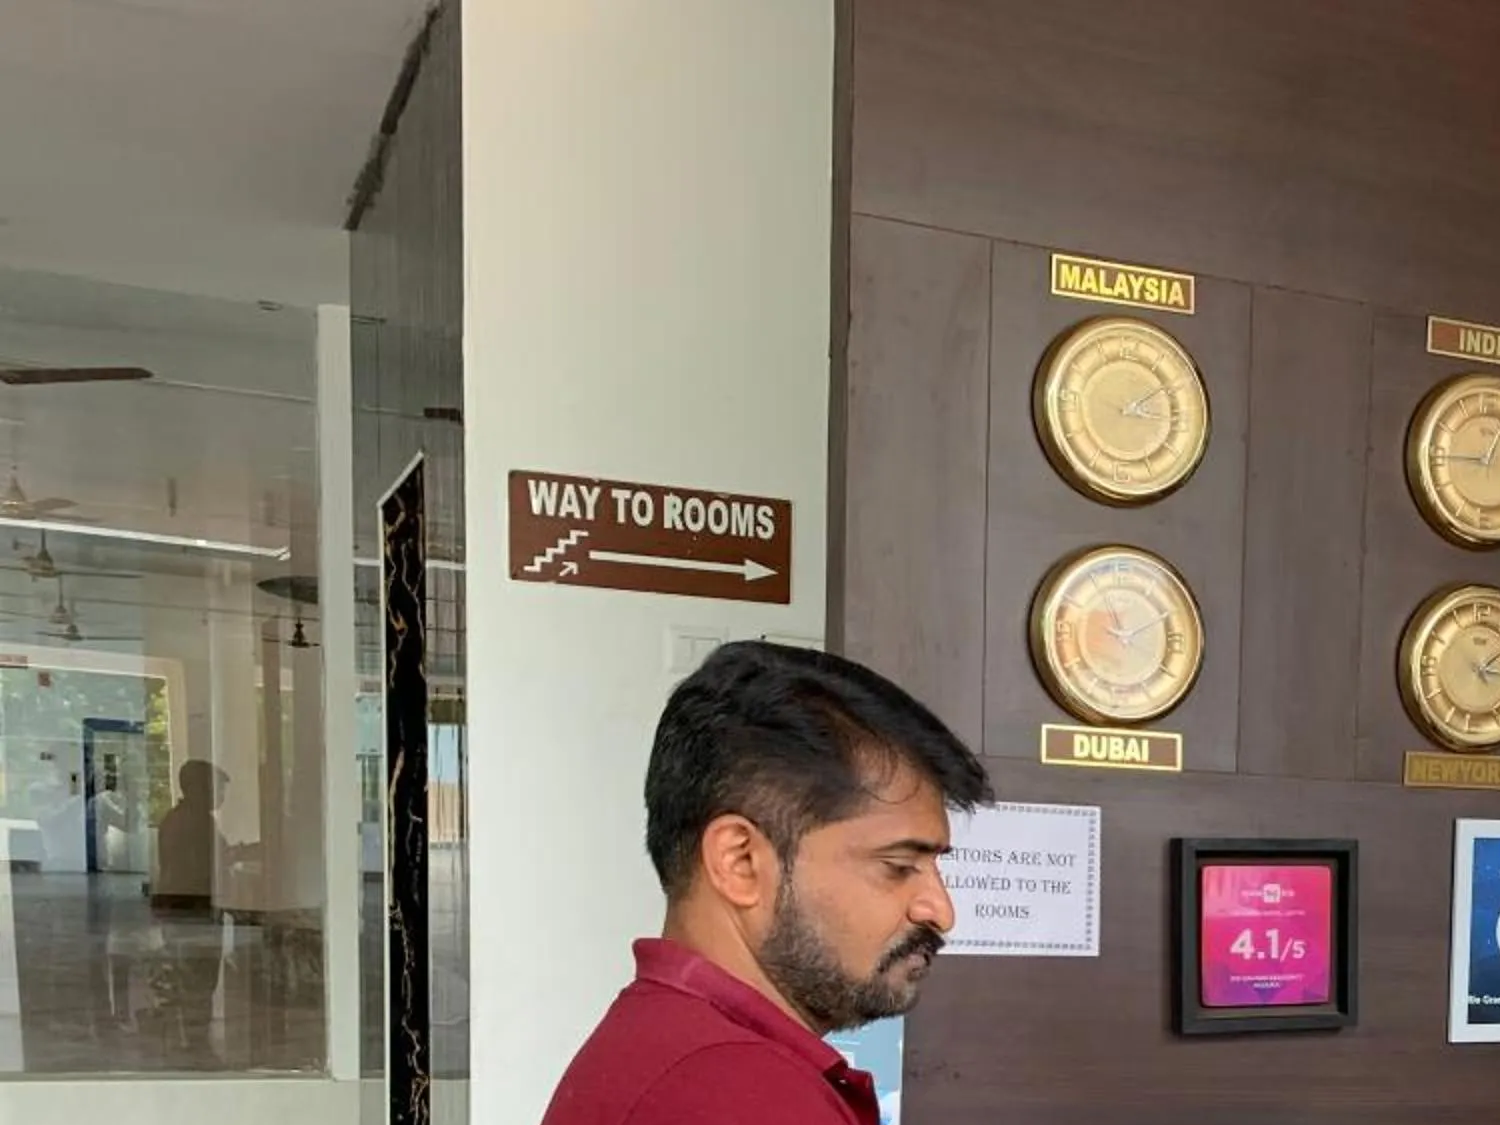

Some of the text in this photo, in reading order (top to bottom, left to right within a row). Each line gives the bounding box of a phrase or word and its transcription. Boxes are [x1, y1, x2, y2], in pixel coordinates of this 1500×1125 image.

[1060, 263, 1185, 307] MALAYSIA
[527, 479, 775, 540] WAY TO ROOMS
[1073, 733, 1149, 763] DUBAI
[1007, 851, 1042, 866] ARE
[1047, 852, 1077, 868] NOT
[944, 875, 1073, 895] LLOWED TO THE
[974, 903, 1030, 919] ROOMS
[1229, 928, 1306, 963] 4.1/5
